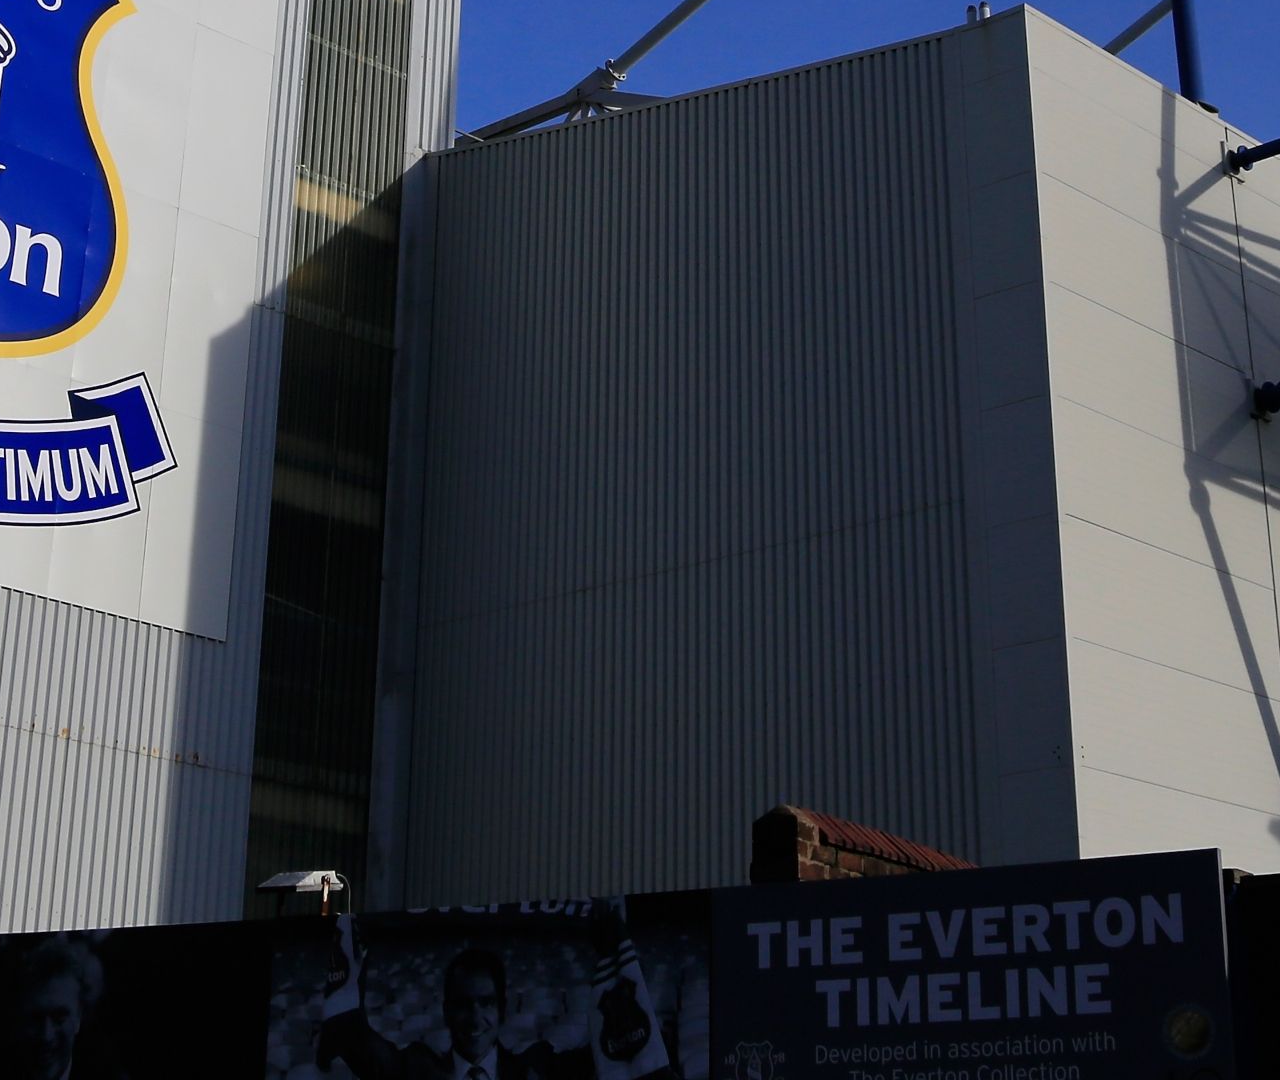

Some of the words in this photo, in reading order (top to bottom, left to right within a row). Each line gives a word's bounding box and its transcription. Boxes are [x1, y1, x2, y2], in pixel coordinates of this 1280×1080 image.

[747, 915, 864, 970] THE
[886, 892, 1185, 963] EVERTON
[815, 961, 1113, 1028] TIMELINE
[814, 1040, 917, 1066] Developed
[923, 1039, 942, 1060] in
[947, 1033, 1065, 1058] association
[1071, 1029, 1117, 1053] with
[976, 1060, 1081, 1080] Collection
